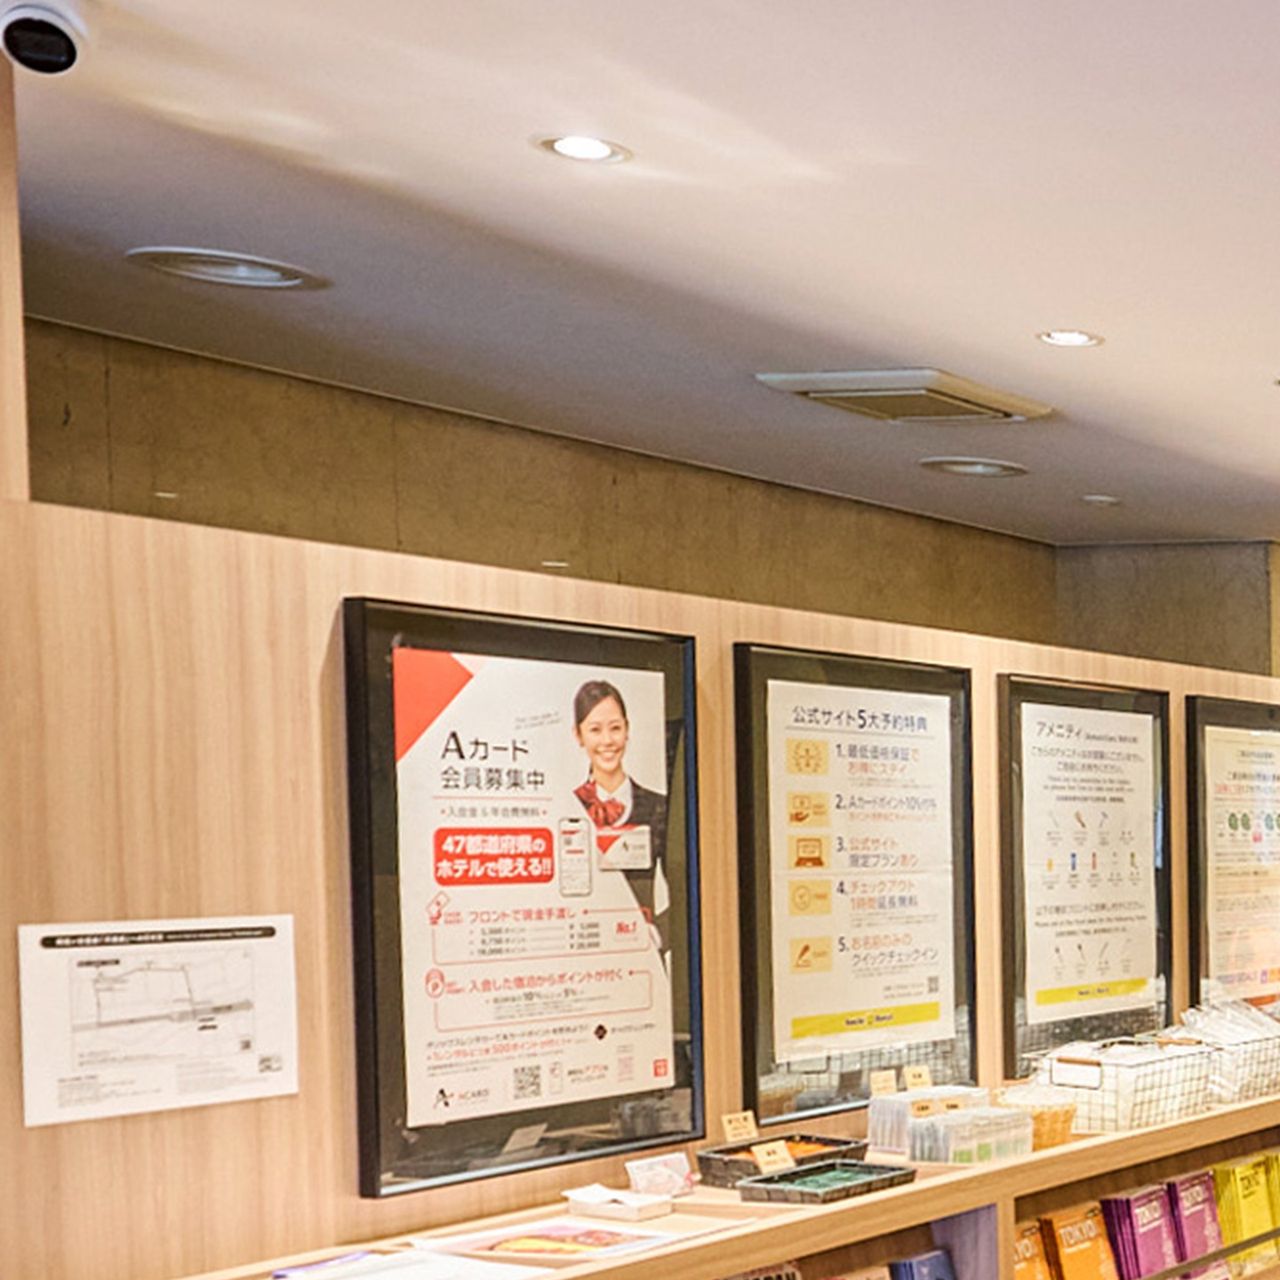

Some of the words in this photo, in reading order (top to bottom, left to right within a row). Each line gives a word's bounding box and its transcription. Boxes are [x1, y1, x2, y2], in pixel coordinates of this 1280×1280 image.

[440, 765, 545, 791] 会員募集中
[441, 834, 547, 855] 47都道府県の
